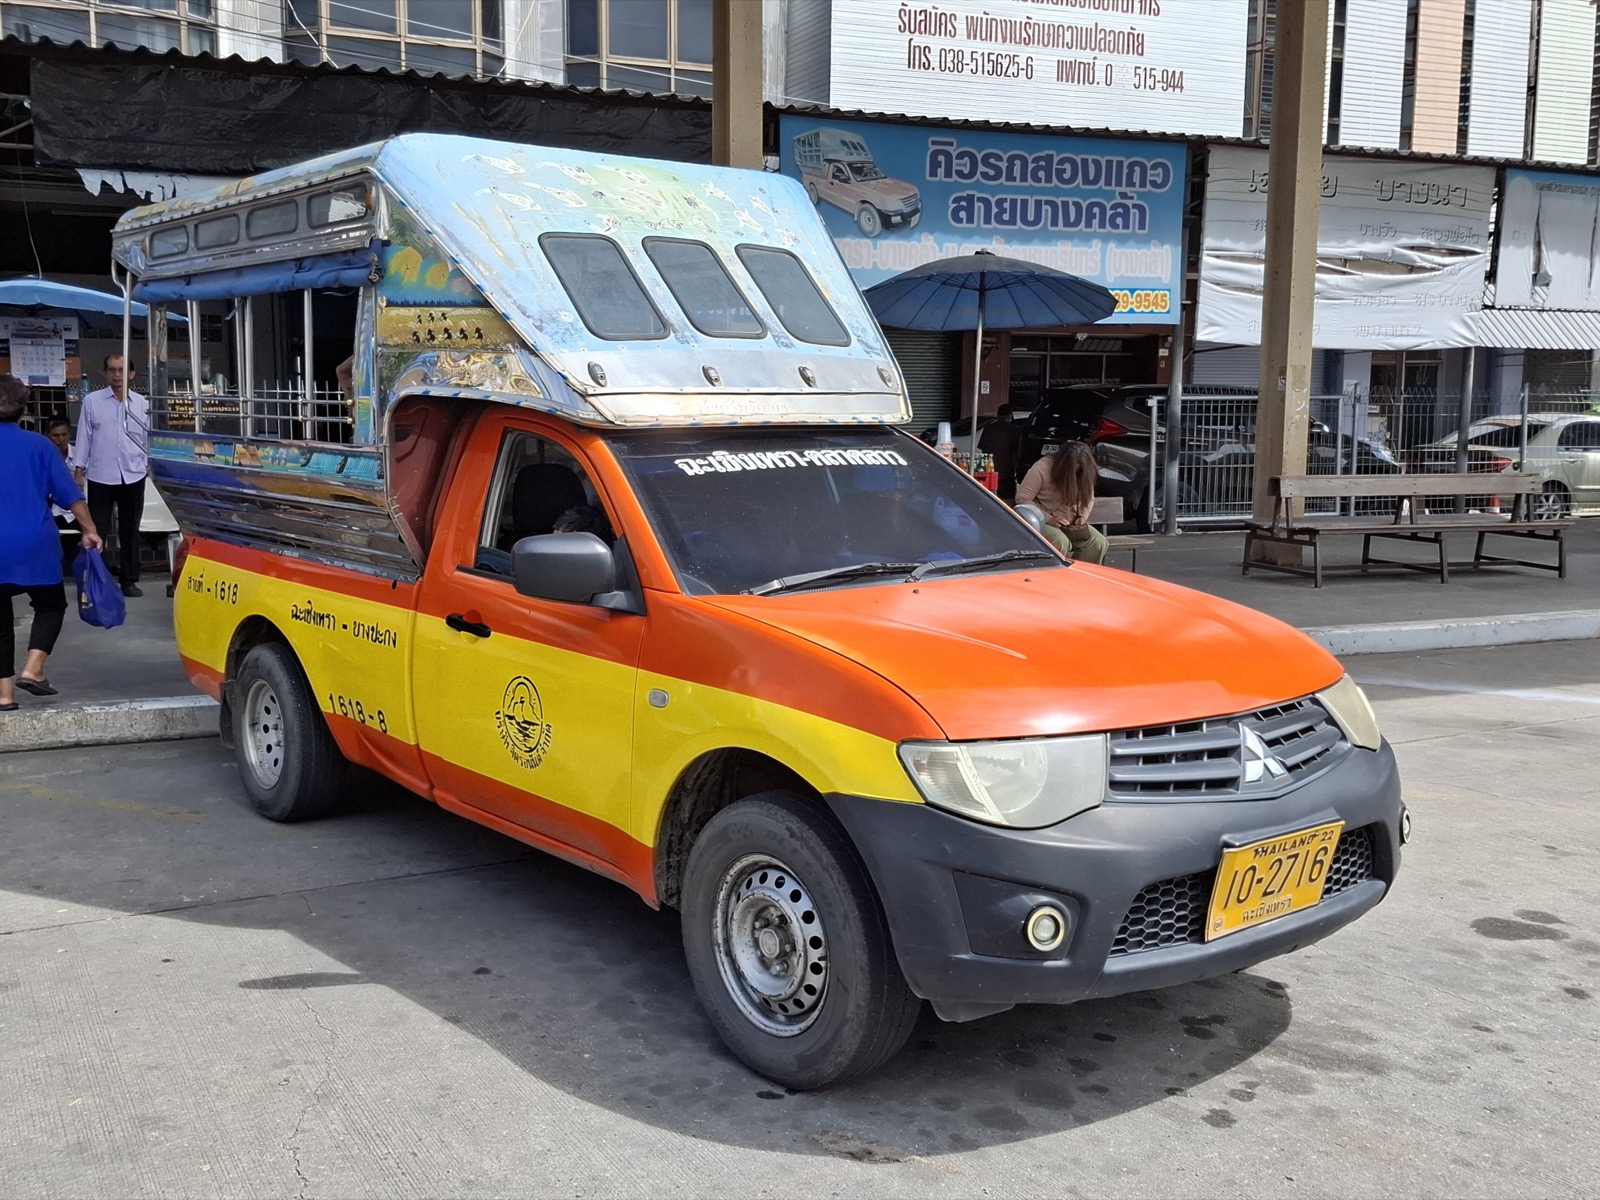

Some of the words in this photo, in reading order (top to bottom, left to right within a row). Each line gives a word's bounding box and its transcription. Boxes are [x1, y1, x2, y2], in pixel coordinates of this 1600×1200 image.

[898, 2, 957, 38] รับสมัคร
[965, 11, 1145, 57] พนักงานรักษาความปลอดภัย
[907, 38, 935, 71] โทร.
[939, 48, 1033, 80] 038-515625-6
[928, 138, 1171, 190] คิวรถสองแถว
[950, 191, 1148, 231] สายบางคล้า
[214, 580, 239, 605] 1618
[291, 599, 336, 631] ฉะเชิงเทรา
[352, 620, 398, 649] บางปะกง
[328, 692, 388, 735] 1618-8
[1223, 845, 1329, 910] 10-2716
[1242, 898, 1292, 922] ฉะเชิงเทรา
